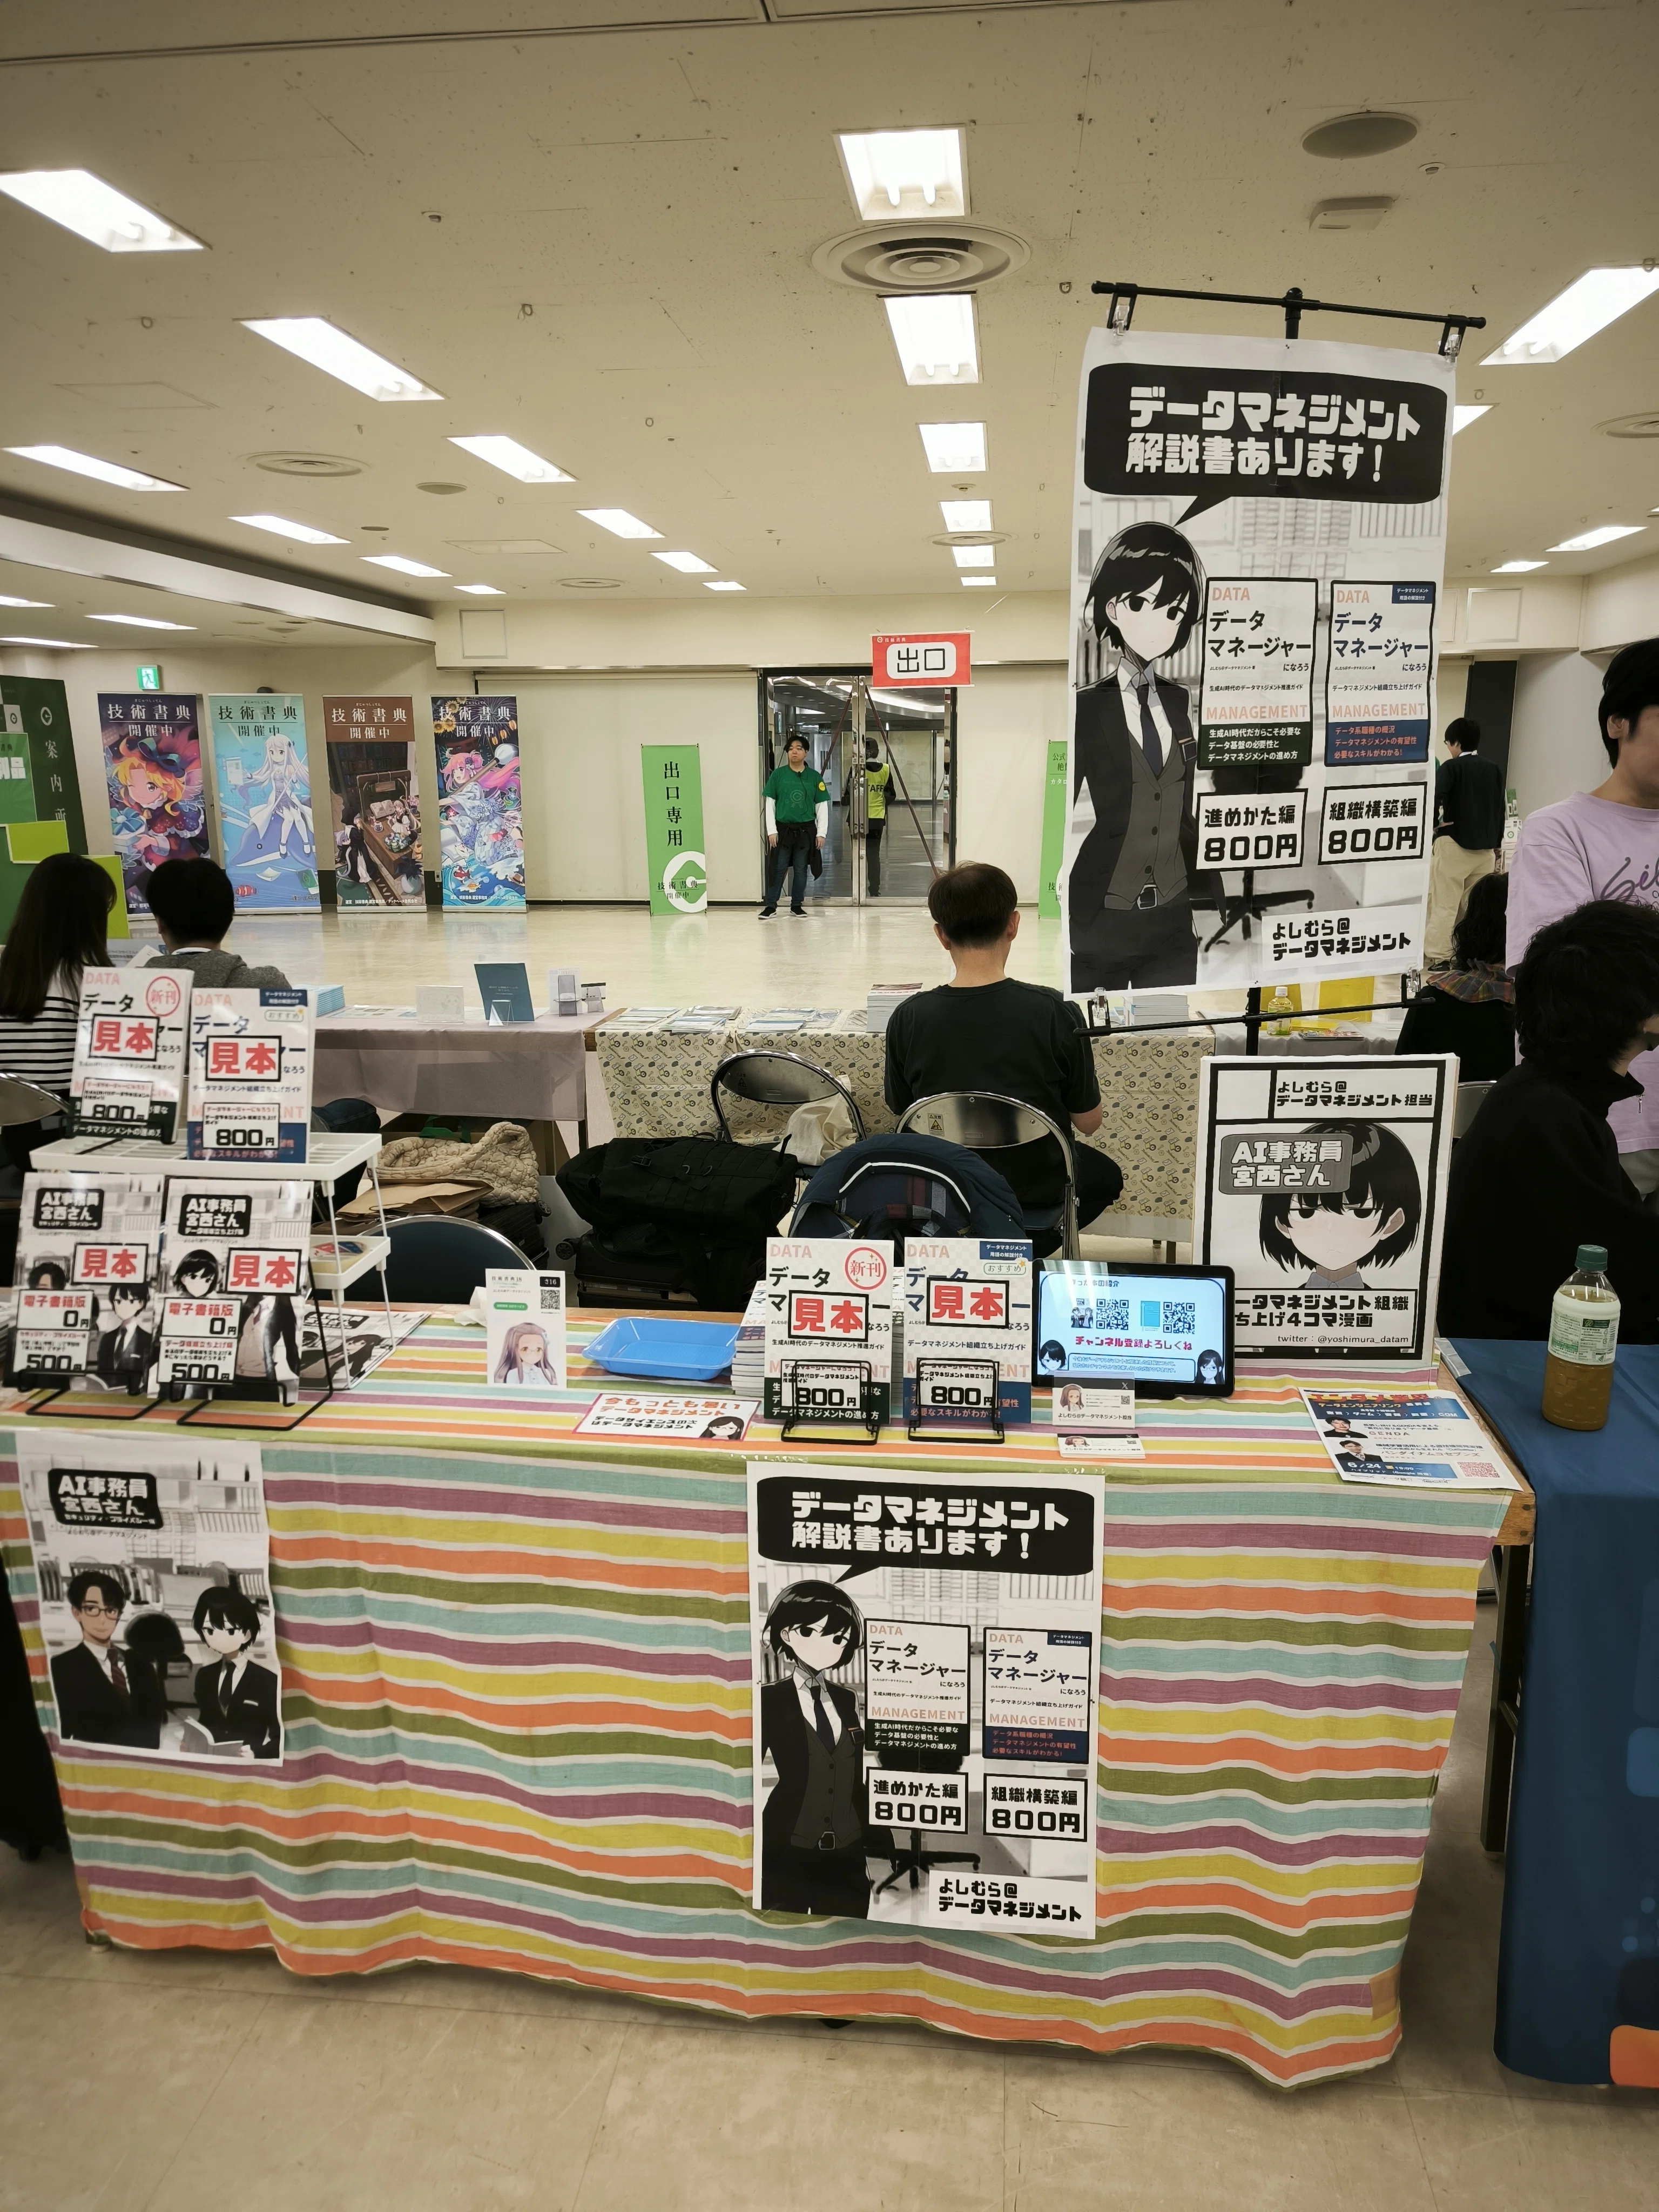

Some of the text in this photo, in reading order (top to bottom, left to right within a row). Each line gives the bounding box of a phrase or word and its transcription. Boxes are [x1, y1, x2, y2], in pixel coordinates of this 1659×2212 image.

[1130, 387, 1420, 441] データマネジメント
[1212, 587, 1250, 601] DATA
[1337, 590, 1370, 603] DATA
[1210, 610, 1265, 632] データ
[1335, 612, 1382, 632] データ
[1208, 637, 1311, 657] マネージャー
[1333, 638, 1428, 657] マネージャー
[897, 648, 946, 673] 出口
[1283, 663, 1309, 671] になろう
[1402, 663, 1427, 671] になろう
[108, 704, 191, 720] 技術書典
[218, 705, 298, 720] 技術書典
[331, 707, 407, 723] 技術書典
[439, 706, 511, 721] 技術書典
[1206, 705, 1307, 720] MANAGEMENT
[1332, 703, 1425, 718] MANAGEMENT
[129, 724, 173, 737] 開催中
[238, 725, 280, 737] 開催中
[349, 727, 390, 739] 開催中
[456, 725, 495, 738] 開催中
[1209, 727, 1301, 738] 生成AI時代だからこそ必要な
[1208, 740, 1279, 750] データ基盤の必要性と
[1052, 753, 1068, 761] 公式
[1208, 751, 1298, 762] データマネジメントの進め方
[45, 740, 66, 821] 案内所
[868, 784, 884, 793] AFF
[664, 761, 683, 847] 出口専用
[1329, 798, 1417, 821] 組織構築編
[1204, 805, 1296, 828] 進めかた編
[1204, 833, 1297, 862] 800円
[1328, 826, 1418, 854] 800円
[657, 881, 698, 892] 技術書典
[1272, 918, 1350, 940] よしむら@
[1272, 933, 1411, 961] データマネジメント
[85, 972, 121, 986] DATA
[83, 993, 134, 1013] データ
[151, 989, 177, 1005] 新刊
[194, 994, 233, 1007] DATA
[192, 1015, 249, 1035] データ
[93, 1021, 154, 1054] 見本
[210, 1042, 276, 1075] 見本
[282, 1065, 306, 1074] なろう
[1278, 1081, 1347, 1093] よしむら@
[1277, 1094, 1433, 1107] データマネジメント担当
[216, 1129, 275, 1146] 800円
[1231, 1139, 1343, 1164] AI事務員
[1231, 1164, 1332, 1188] 宮西さん
[186, 1198, 246, 1212] AI事務員
[186, 1213, 240, 1227] 宮西さん
[770, 1244, 812, 1258] DATA
[907, 1244, 950, 1258] DATA
[80, 1249, 138, 1278] 見本
[230, 1255, 296, 1288] 見本
[850, 1260, 881, 1278] 新刊
[769, 1266, 831, 1288] データ
[168, 1303, 234, 1317] 電子書籍版
[932, 1285, 1003, 1320] 見本
[1235, 1294, 1409, 1311] ータマネジメント組織
[63, 1310, 89, 1328] 0円
[793, 1298, 864, 1333] 見本
[1235, 1312, 1373, 1327] ち上げ4コマ漫画
[209, 1318, 237, 1335] 0円
[868, 1323, 890, 1332] なろう
[772, 1339, 885, 1350] 生成AI時代のデータマネジメント推進ガイド
[907, 1340, 1026, 1351] データマネジメント組織立ち上げガイド
[1075, 1336, 1193, 1351] チャンネル登録よろしくね
[1318, 1335, 1409, 1344] @yoshimura_datam
[795, 1387, 857, 1406] 800円
[931, 1386, 993, 1406] 800円
[599, 1406, 725, 1416] データマネジメント
[58, 1475, 147, 1499] AI事務員
[60, 1496, 145, 1516] 宮西さん
[792, 1491, 1069, 1531] データマネジメント
[869, 1624, 903, 1636] DATA
[989, 1633, 1023, 1644] DATA
[869, 1640, 918, 1657] データ
[988, 1648, 1038, 1664] データ
[869, 1658, 966, 1677] マネージャー
[988, 1667, 1087, 1684] マネージャー
[873, 1691, 961, 1701] 生成AI時代のデータマネジメント推進ガイド
[1060, 1688, 1087, 1696] になろう
[989, 1698, 1083, 1709] データマネジメント組織立ち上げガイド
[871, 1706, 965, 1721] MANAGEMENT
[989, 1713, 1085, 1728] MANAGEMENT
[874, 1722, 959, 1734] 生成AI時代だからこそ必要な
[874, 1731, 939, 1741] データ基盤の必要性と
[874, 1739, 957, 1750] データマネジメントの進め方
[992, 1738, 1077, 1750] データマネジメントの有望性
[873, 1779, 959, 1799] 進めかた編
[991, 1786, 1078, 1806] 組織構築編
[874, 1801, 961, 1826] 800円
[992, 1809, 1080, 1833] 800円
[939, 1878, 1017, 1898] よしむら@
[939, 1896, 1082, 1923] データマネジメント
